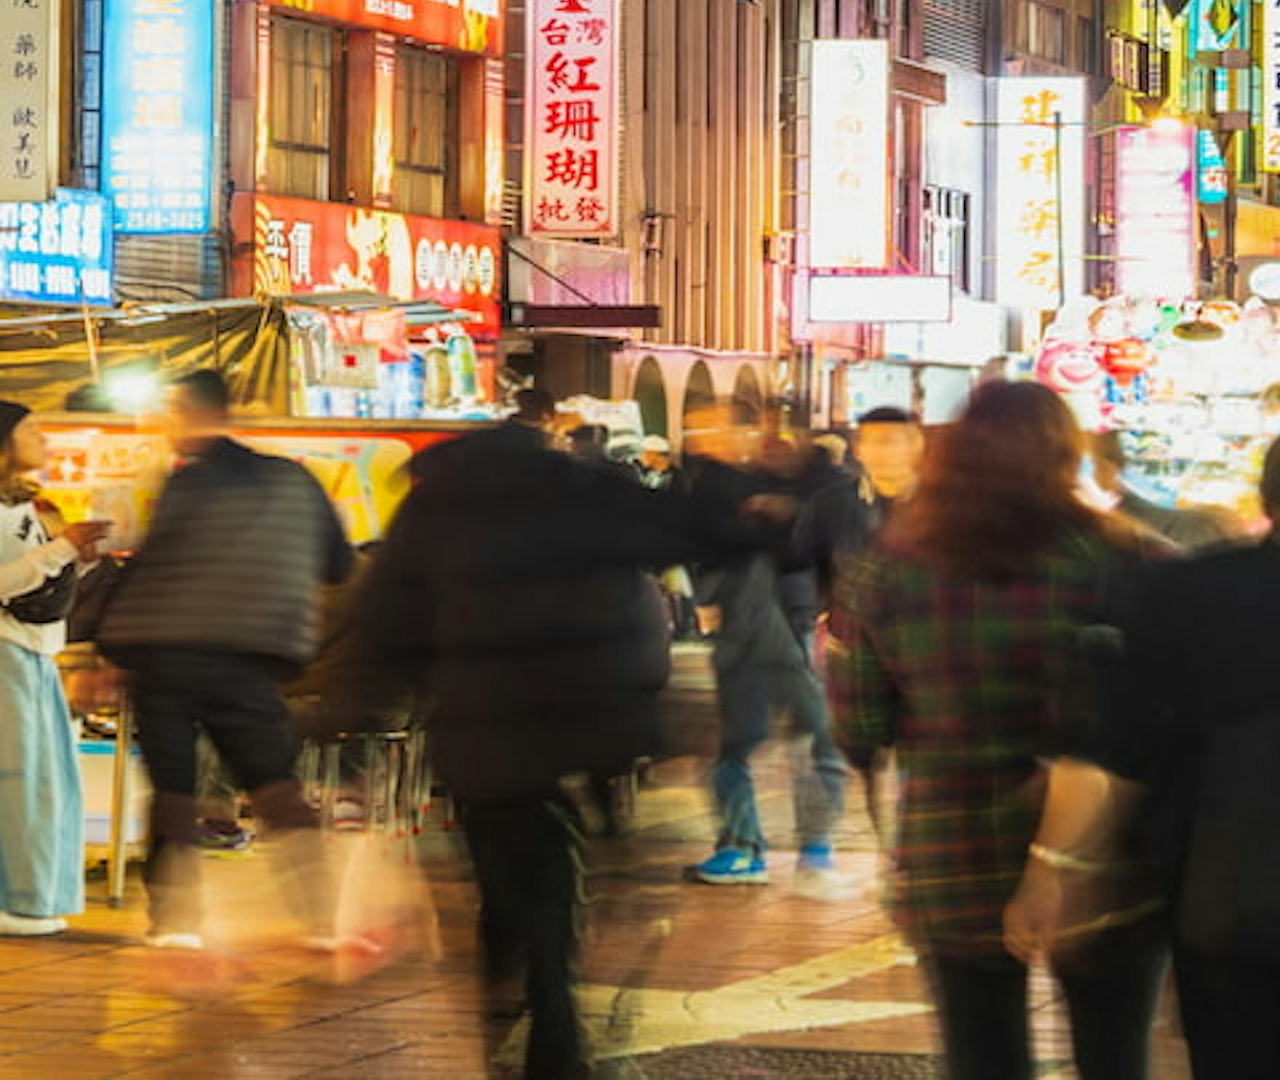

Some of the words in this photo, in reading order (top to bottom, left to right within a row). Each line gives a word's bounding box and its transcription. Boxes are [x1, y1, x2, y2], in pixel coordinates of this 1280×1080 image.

[540, 18, 607, 47] 台灣
[544, 50, 601, 192] 紅珊瑚
[538, 196, 606, 223] 批發
